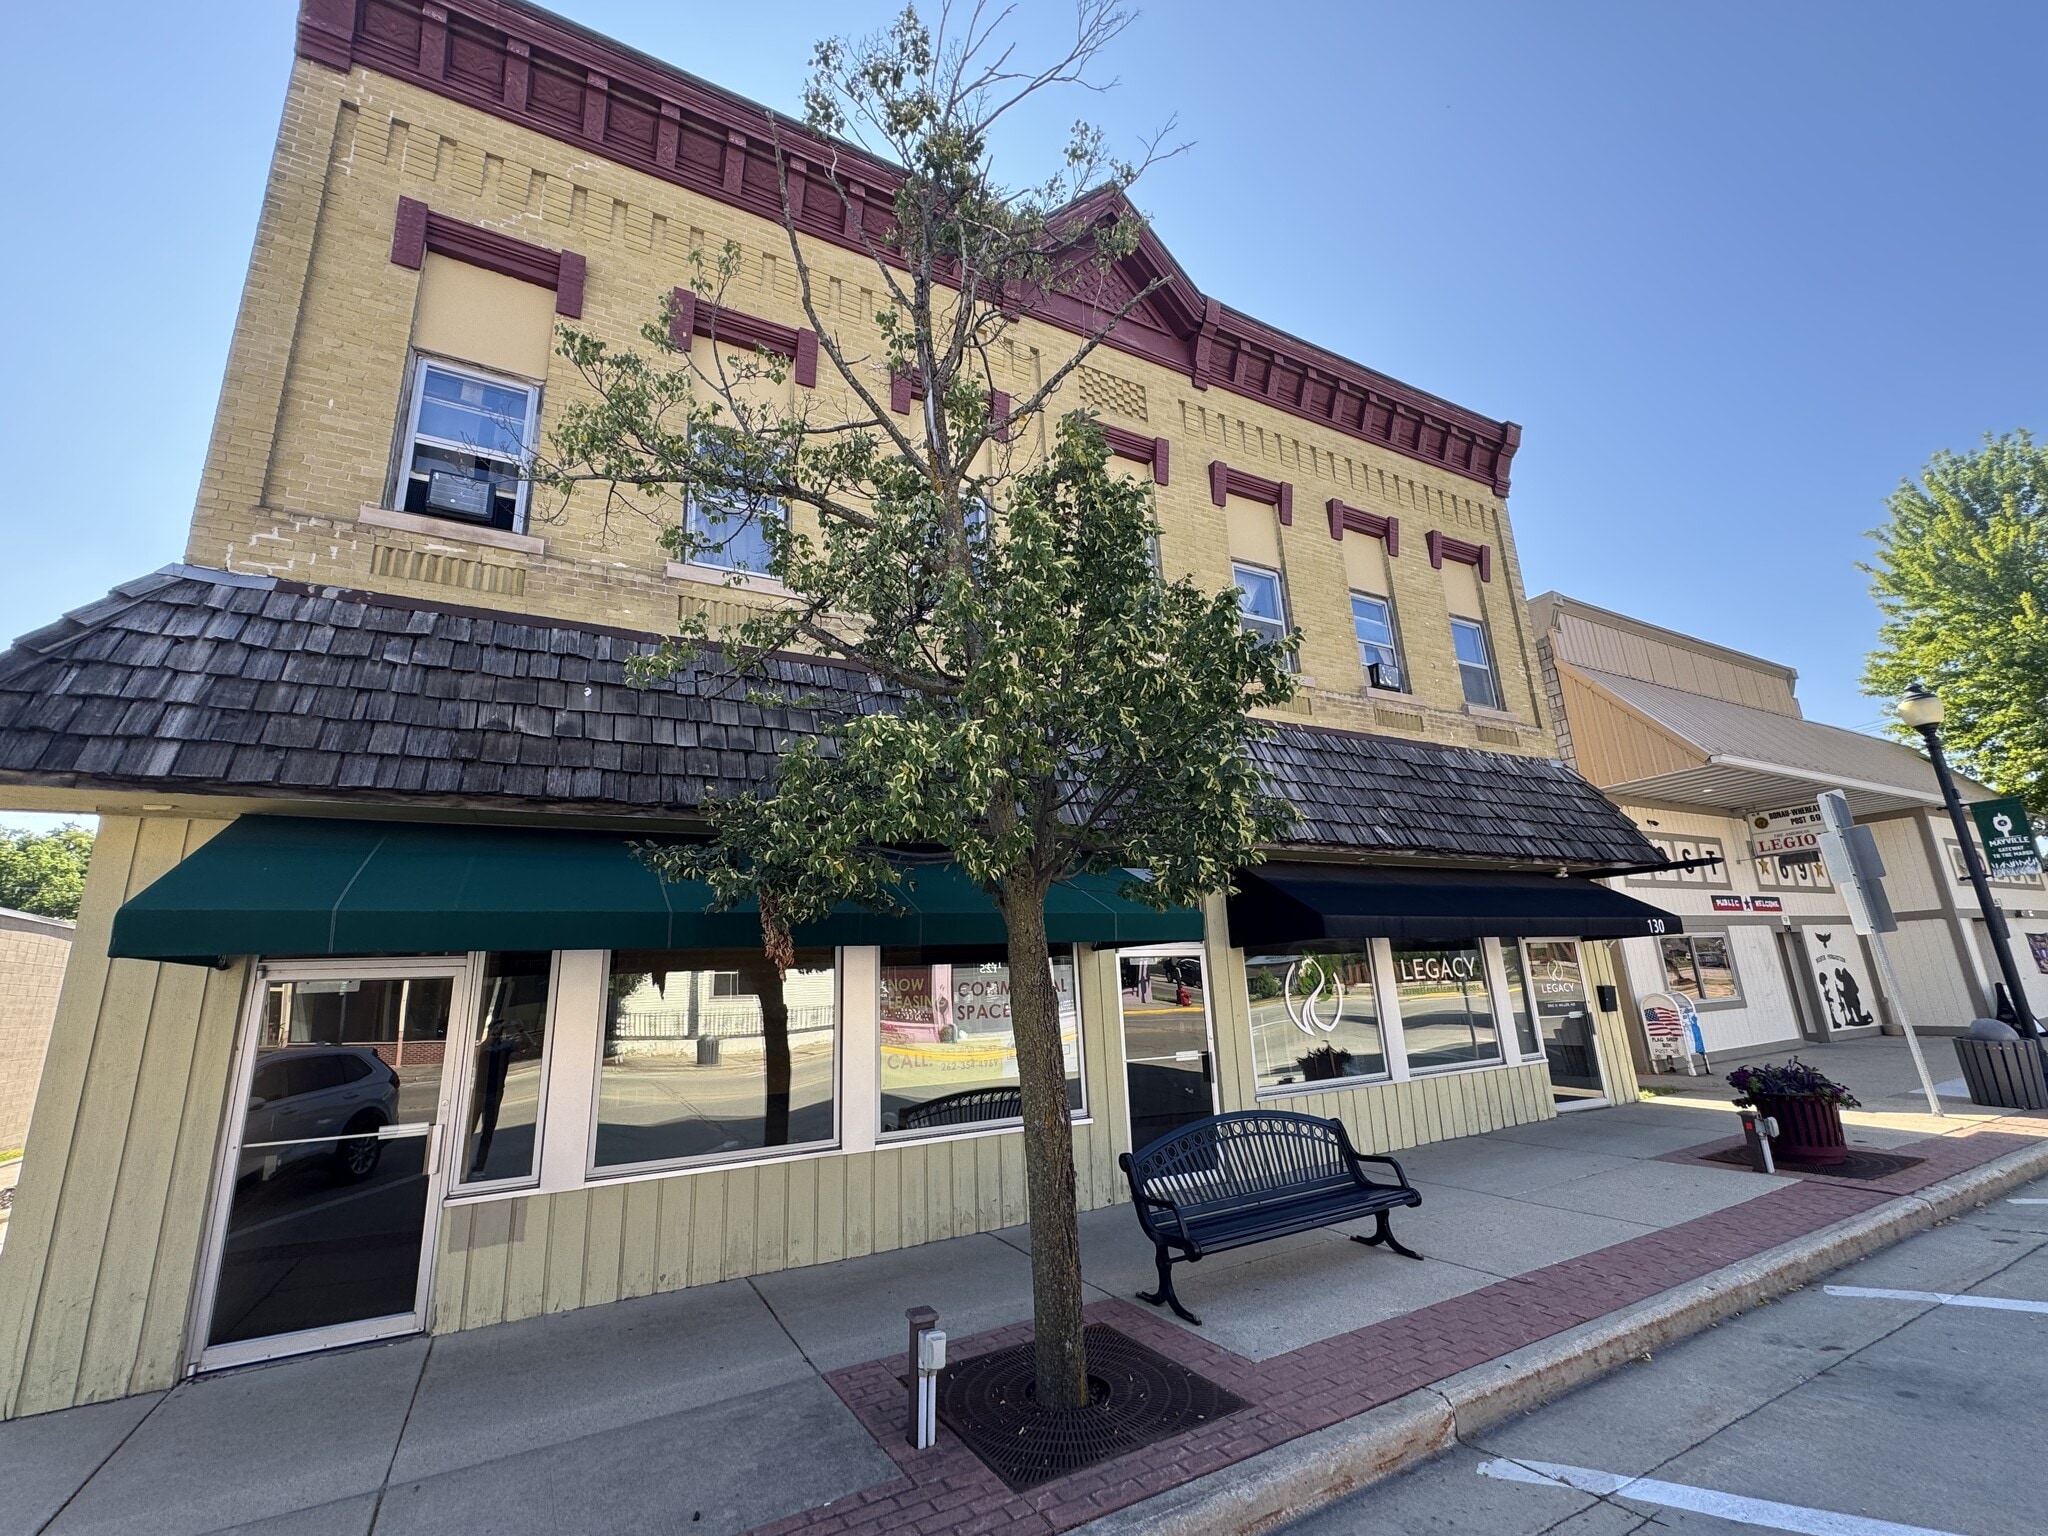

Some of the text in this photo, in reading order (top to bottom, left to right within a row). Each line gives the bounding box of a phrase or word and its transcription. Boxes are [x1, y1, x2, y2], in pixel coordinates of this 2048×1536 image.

[1790, 814, 1822, 825] POST 69
[1758, 834, 1817, 852] LEGIO
[1988, 836, 2031, 847] MAYVILLE
[1715, 899, 1780, 908] PUBLIC WELCOME
[1647, 918, 1665, 934] 130
[1400, 957, 1475, 980] LEGACY
[887, 978, 925, 992] NOW
[958, 978, 1068, 997] COMMAL
[1541, 983, 1574, 993] LEGACY
[887, 995, 947, 1010] LEASING
